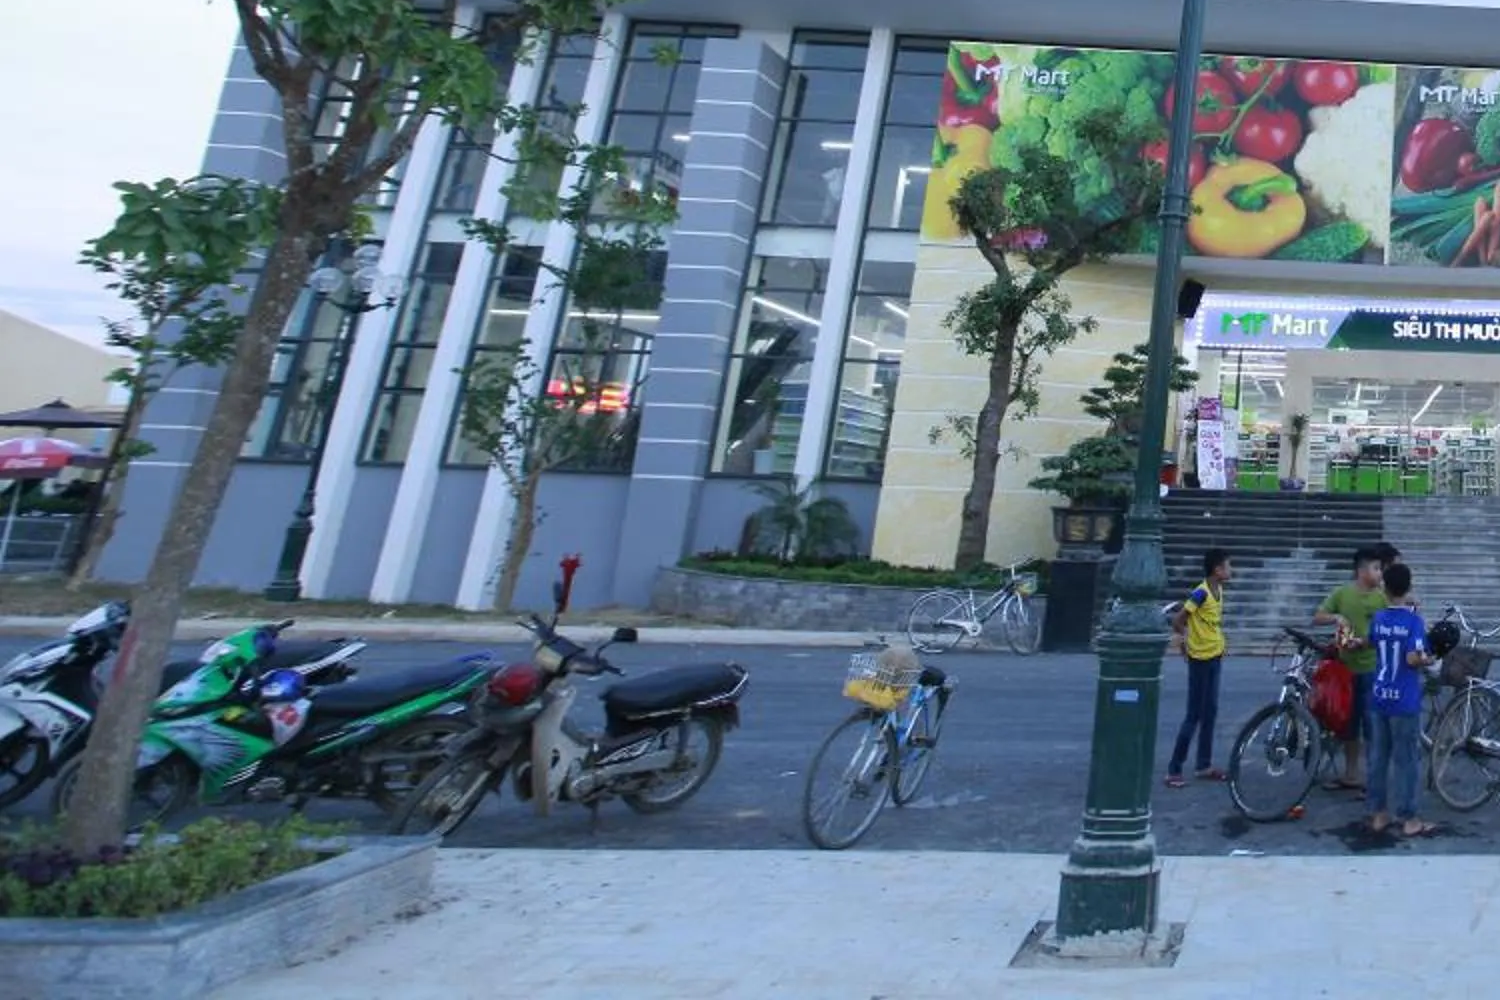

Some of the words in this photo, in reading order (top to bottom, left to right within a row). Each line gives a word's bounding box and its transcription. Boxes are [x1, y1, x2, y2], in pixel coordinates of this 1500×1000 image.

[1021, 66, 1069, 85] Mart
[1420, 85, 1459, 103] MT
[1271, 313, 1329, 337] Mart
[1393, 315, 1431, 338] SIÊU
[1433, 321, 1460, 342] THỊ
